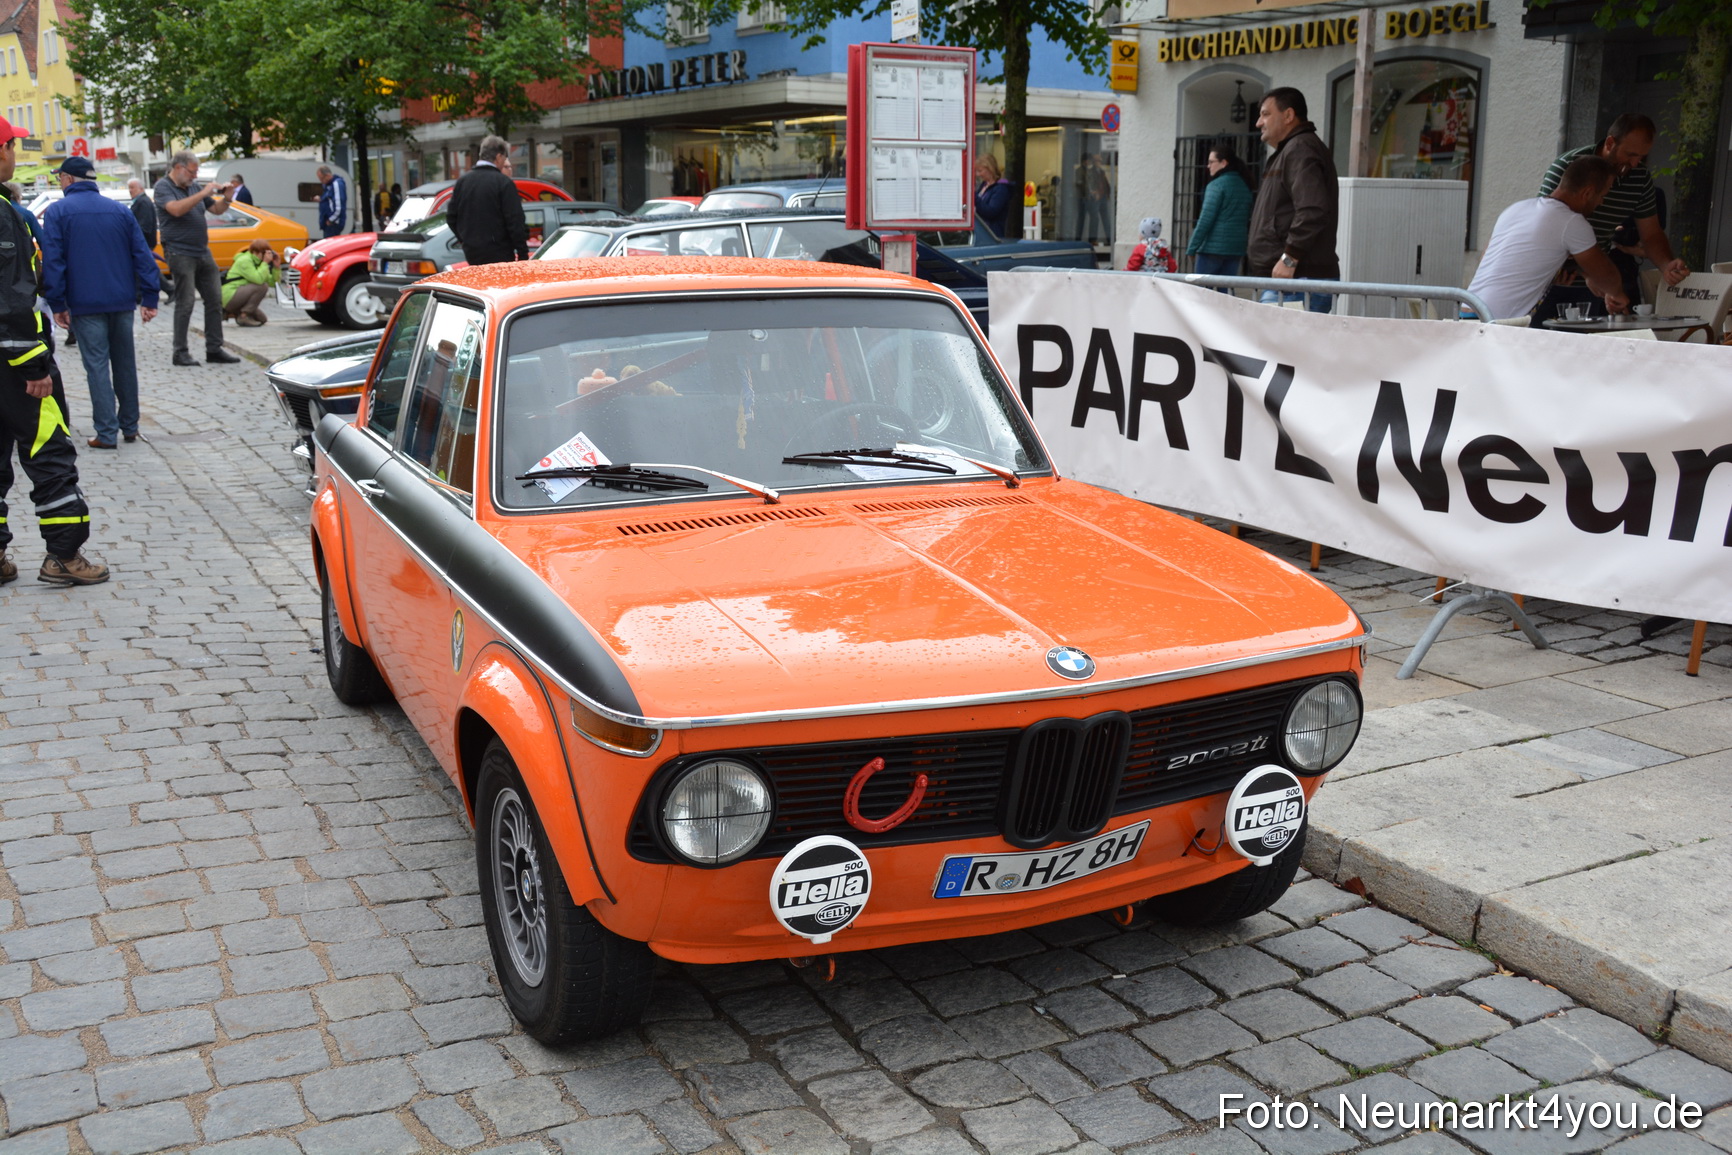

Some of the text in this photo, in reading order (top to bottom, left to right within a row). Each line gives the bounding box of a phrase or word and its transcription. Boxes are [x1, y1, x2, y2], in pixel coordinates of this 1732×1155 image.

[1157, 0, 1495, 63] BUCHHANDLUNG BOEGL
[587, 50, 747, 100] ANTON PETER
[1017, 323, 1335, 485] PARTL
[1048, 646, 1086, 659] BMW
[1167, 735, 1269, 770] 2002ti
[1285, 787, 1300, 797] 500
[1238, 800, 1300, 830] Hella
[1264, 829, 1289, 842] HELLA
[844, 861, 864, 872] 500
[964, 828, 1145, 891] R HZ 8H
[783, 875, 864, 907] Hella
[945, 881, 956, 890] D
[819, 905, 851, 918] HELLA
